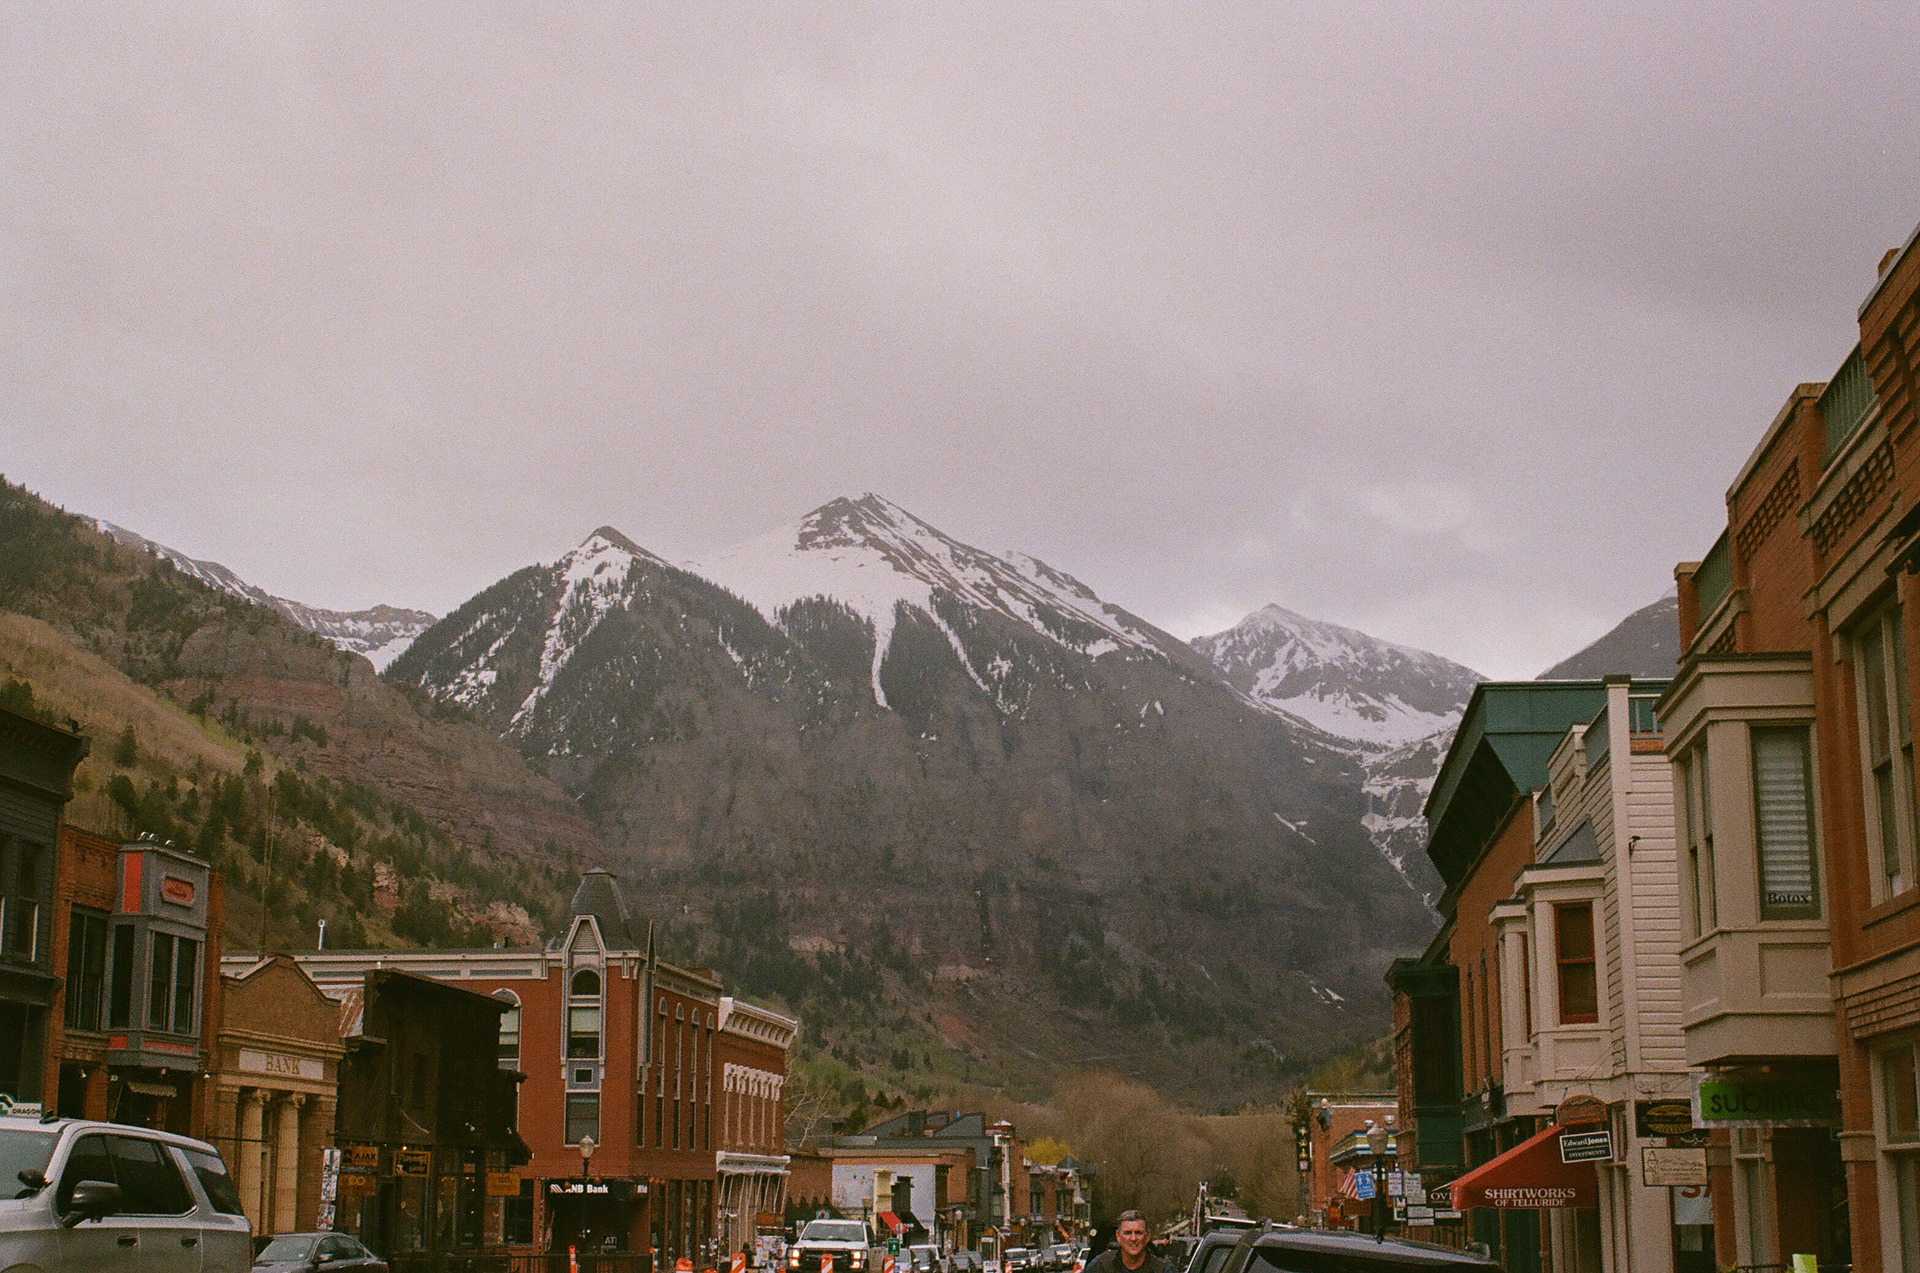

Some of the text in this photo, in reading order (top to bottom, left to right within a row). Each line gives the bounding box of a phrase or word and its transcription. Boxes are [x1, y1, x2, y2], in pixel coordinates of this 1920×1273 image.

[1767, 892, 1810, 904] Botox
[265, 1054, 300, 1075] BANK
[1710, 1084, 1819, 1114] sublime
[355, 1153, 376, 1161] AJAX
[586, 1184, 609, 1194] Bank
[1484, 1187, 1577, 1199] SHIRTWORKS
[1494, 1198, 1567, 1207] OF TELLURIDE
